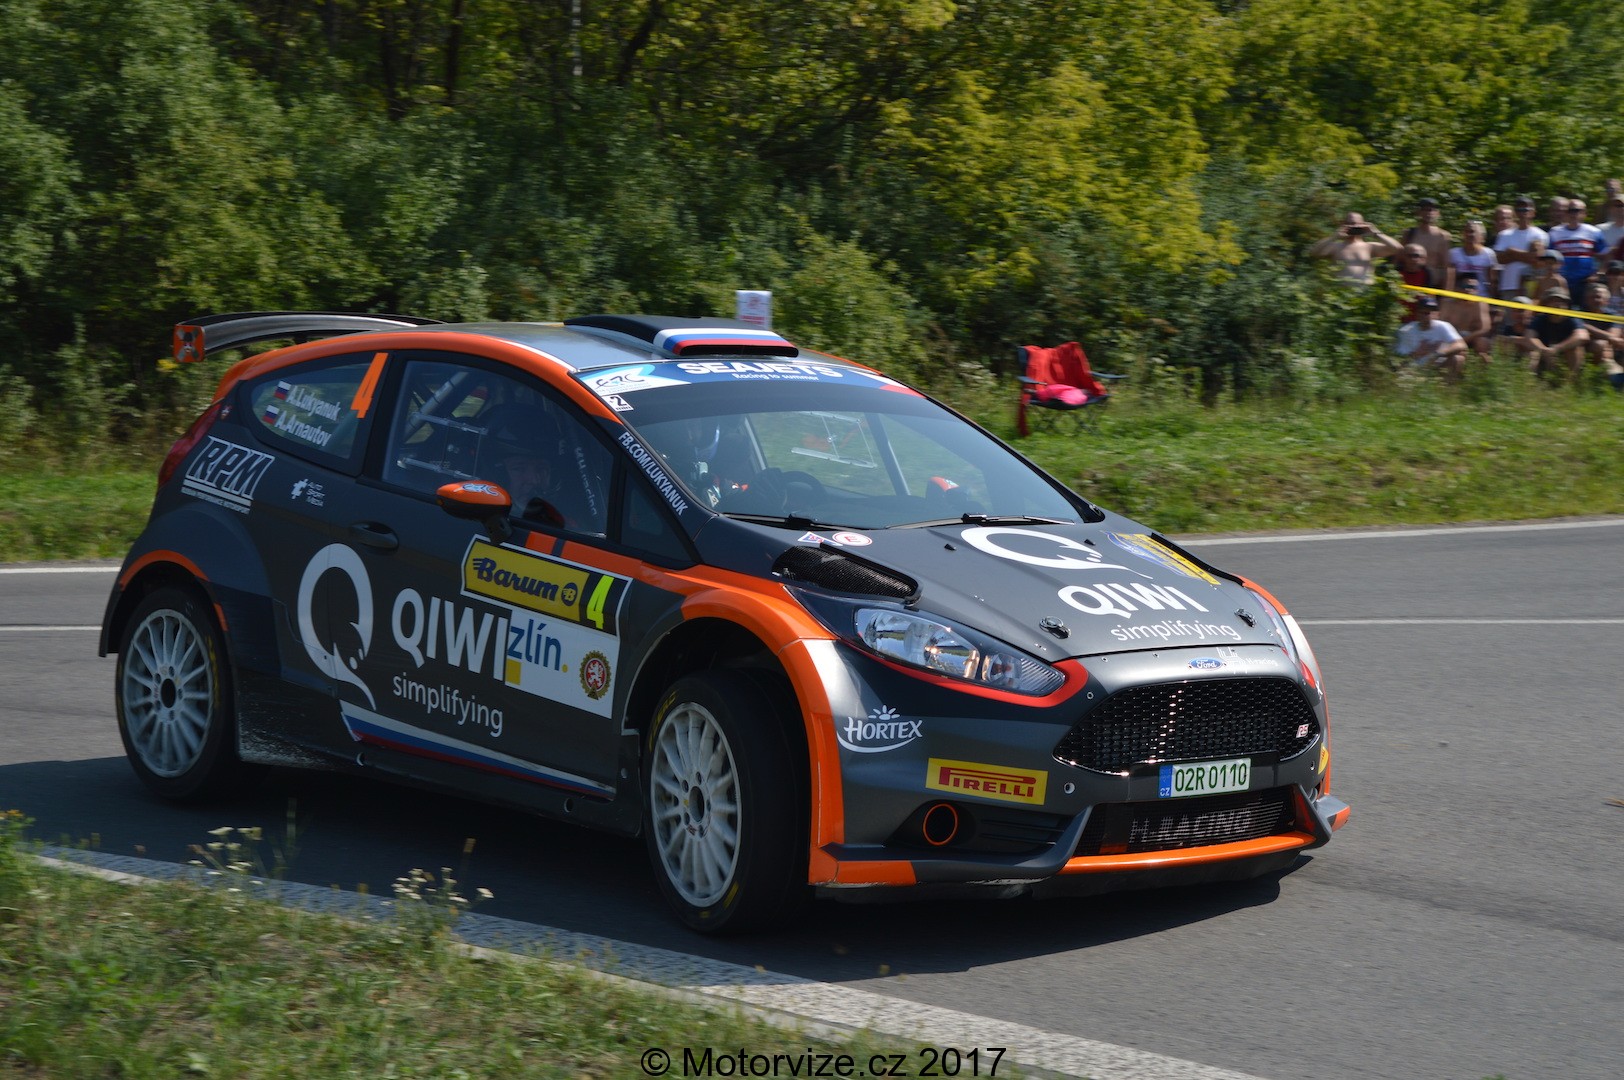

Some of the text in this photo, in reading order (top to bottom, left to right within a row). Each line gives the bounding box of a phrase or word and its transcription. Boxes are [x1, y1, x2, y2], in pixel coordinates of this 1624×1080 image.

[677, 362, 843, 378] SEAJETS
[286, 384, 342, 421] A.Lukyanuk
[275, 410, 332, 447] A.Arnautov
[185, 435, 275, 499] RPM
[618, 431, 688, 516] FB.COM/LUKYANUK
[473, 557, 559, 602] Barum
[586, 575, 615, 630] 4
[1057, 583, 1210, 620] QIWI
[391, 588, 509, 683] QIWI
[1110, 619, 1243, 641] simplifying
[1197, 658, 1217, 669] Ford
[393, 672, 504, 738] simplifying
[939, 766, 1037, 797] PIRELLI
[1160, 787, 1170, 797] CZ
[1175, 763, 1247, 792] 02R 0110
